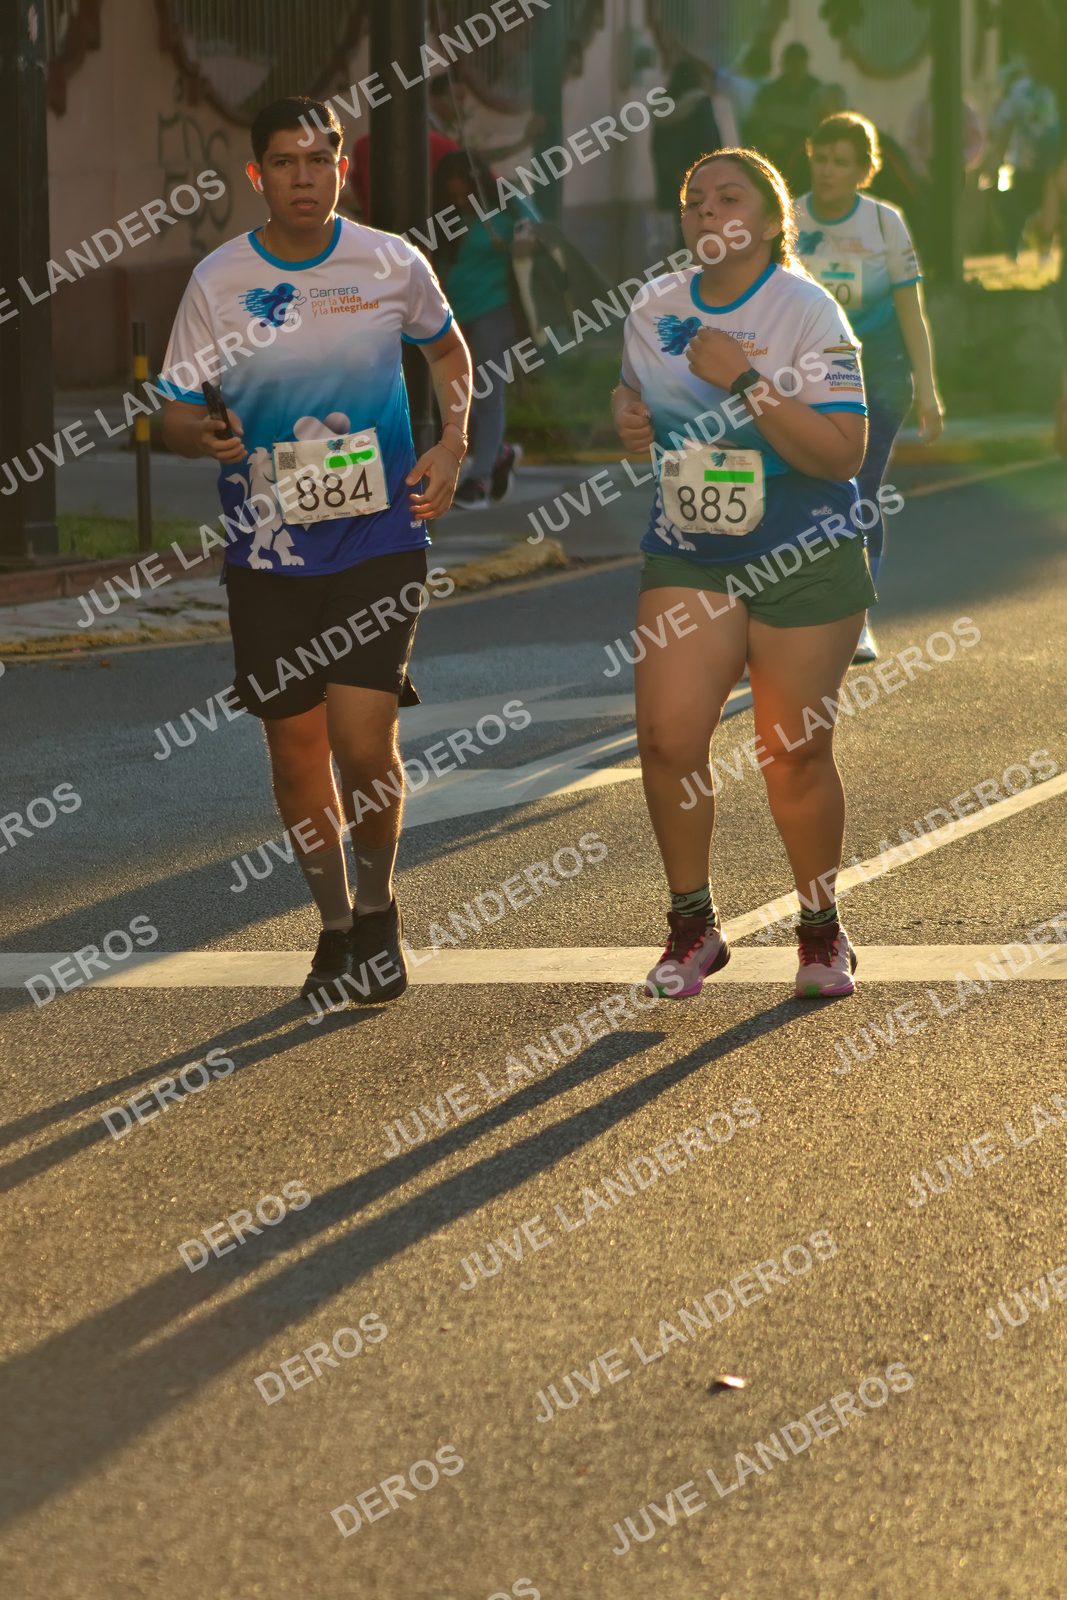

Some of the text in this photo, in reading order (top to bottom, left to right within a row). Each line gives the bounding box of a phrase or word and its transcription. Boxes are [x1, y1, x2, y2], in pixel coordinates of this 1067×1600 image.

[310, 286, 359, 298] Carrera
[339, 295, 362, 304] Vida
[330, 300, 379, 314] Integridad
[296, 467, 373, 511] 884
[678, 486, 746, 524] 885
